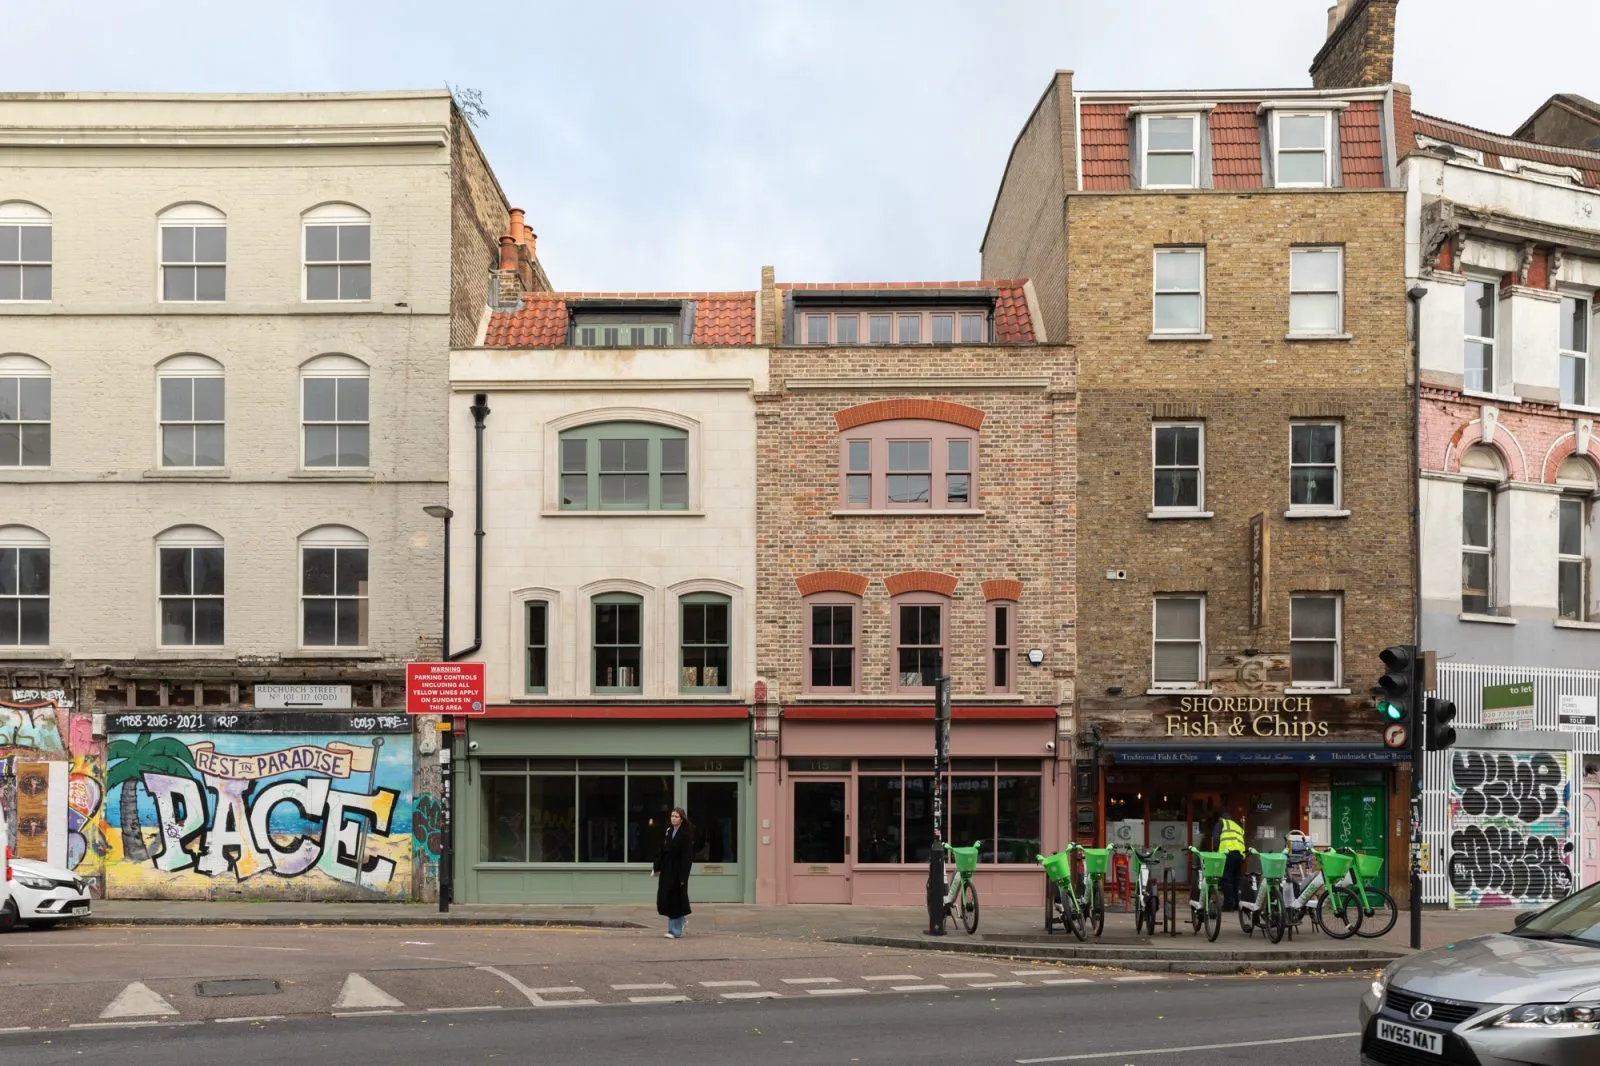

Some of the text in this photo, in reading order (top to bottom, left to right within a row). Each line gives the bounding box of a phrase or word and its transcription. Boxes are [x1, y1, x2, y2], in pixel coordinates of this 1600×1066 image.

[1510, 685, 1532, 694] to let
[1180, 696, 1312, 713] SHOREDITCH
[1164, 713, 1329, 742] Fish & Chips
[198, 754, 238, 777] REST
[257, 748, 344, 776] PARADISE
[1180, 753, 1199, 762] Chips
[1331, 752, 1367, 760] Handmade
[704, 761, 722, 770] 113
[142, 771, 397, 883] PACE
[1381, 1023, 1437, 1050] HV55 NAT
